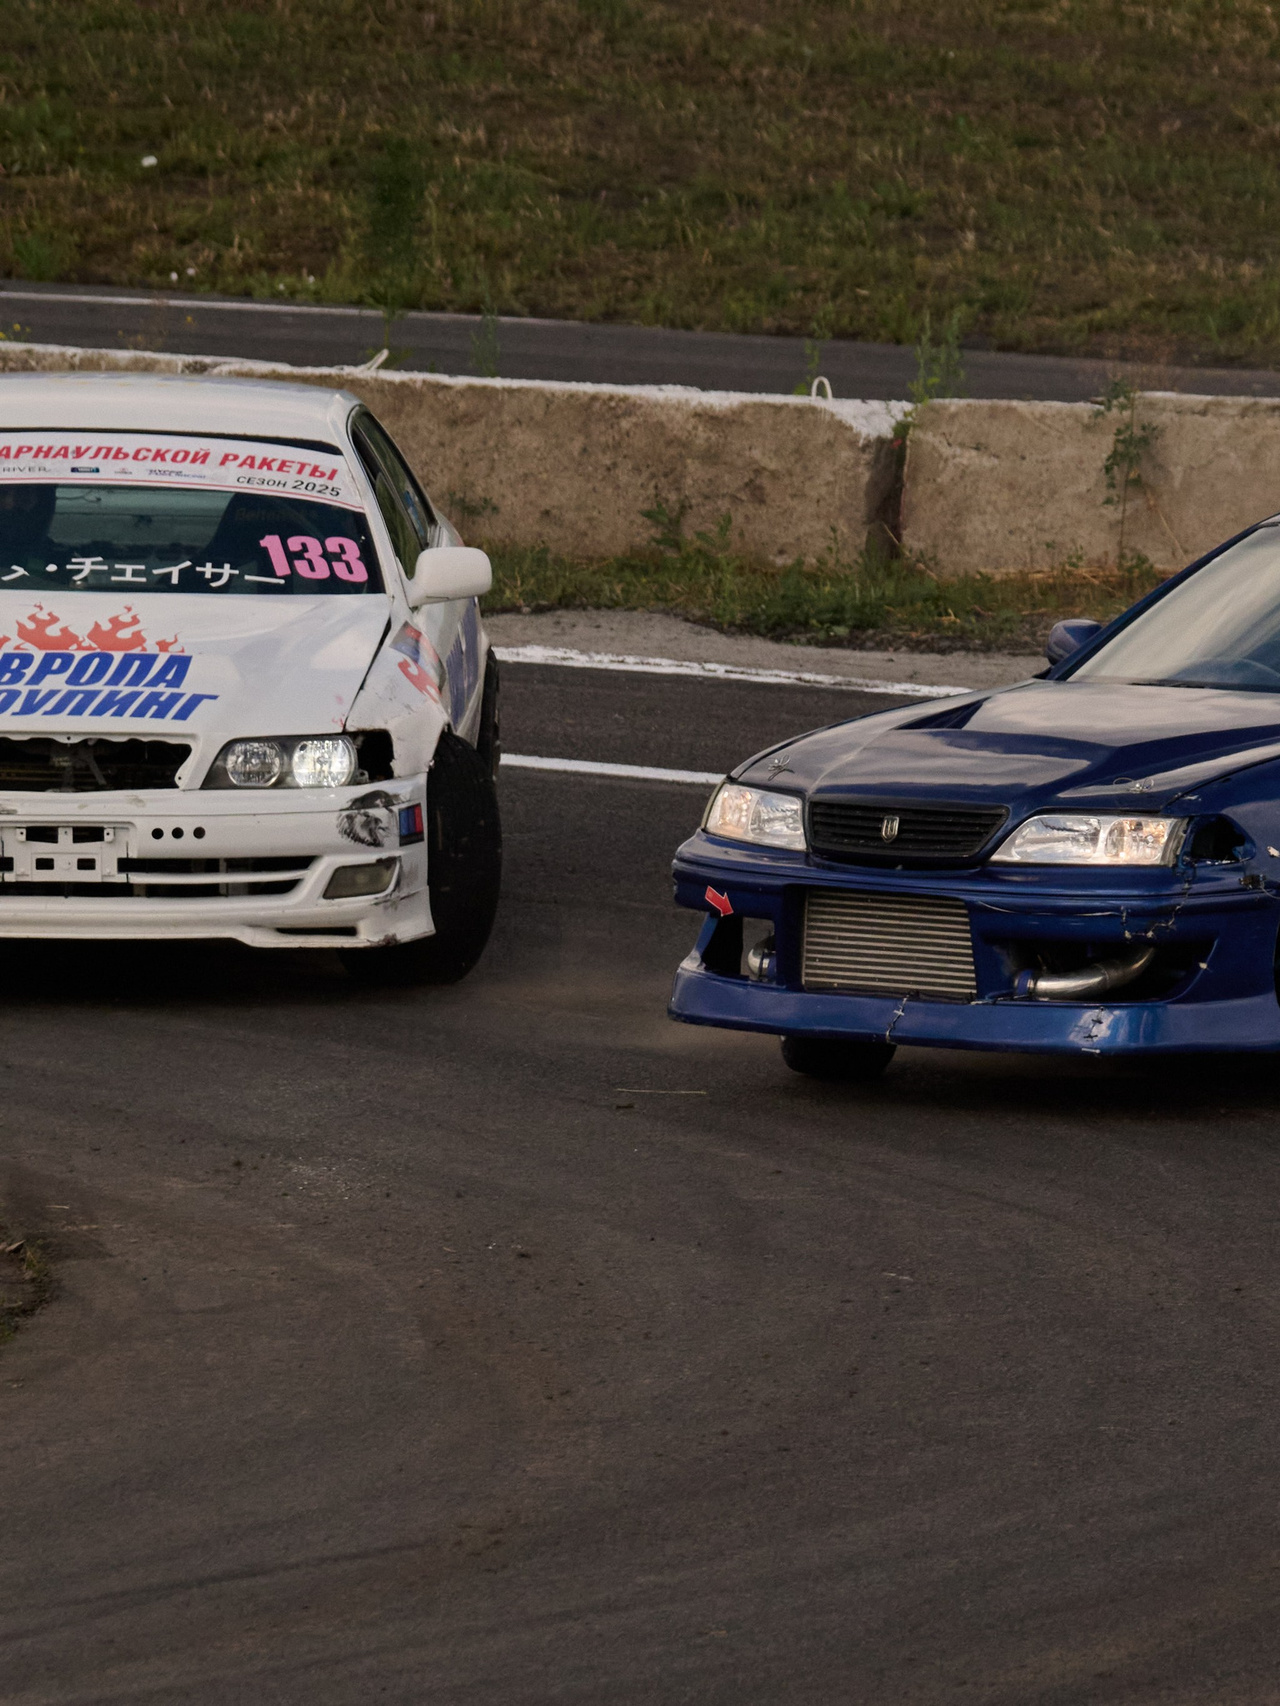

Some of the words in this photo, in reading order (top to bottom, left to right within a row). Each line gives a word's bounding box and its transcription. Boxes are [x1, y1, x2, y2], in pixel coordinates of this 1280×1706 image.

[219, 453, 338, 481] РАКЕТЫ
[236, 476, 287, 488] СЕЗОН
[292, 480, 342, 497] 2025
[259, 534, 368, 582] 133
